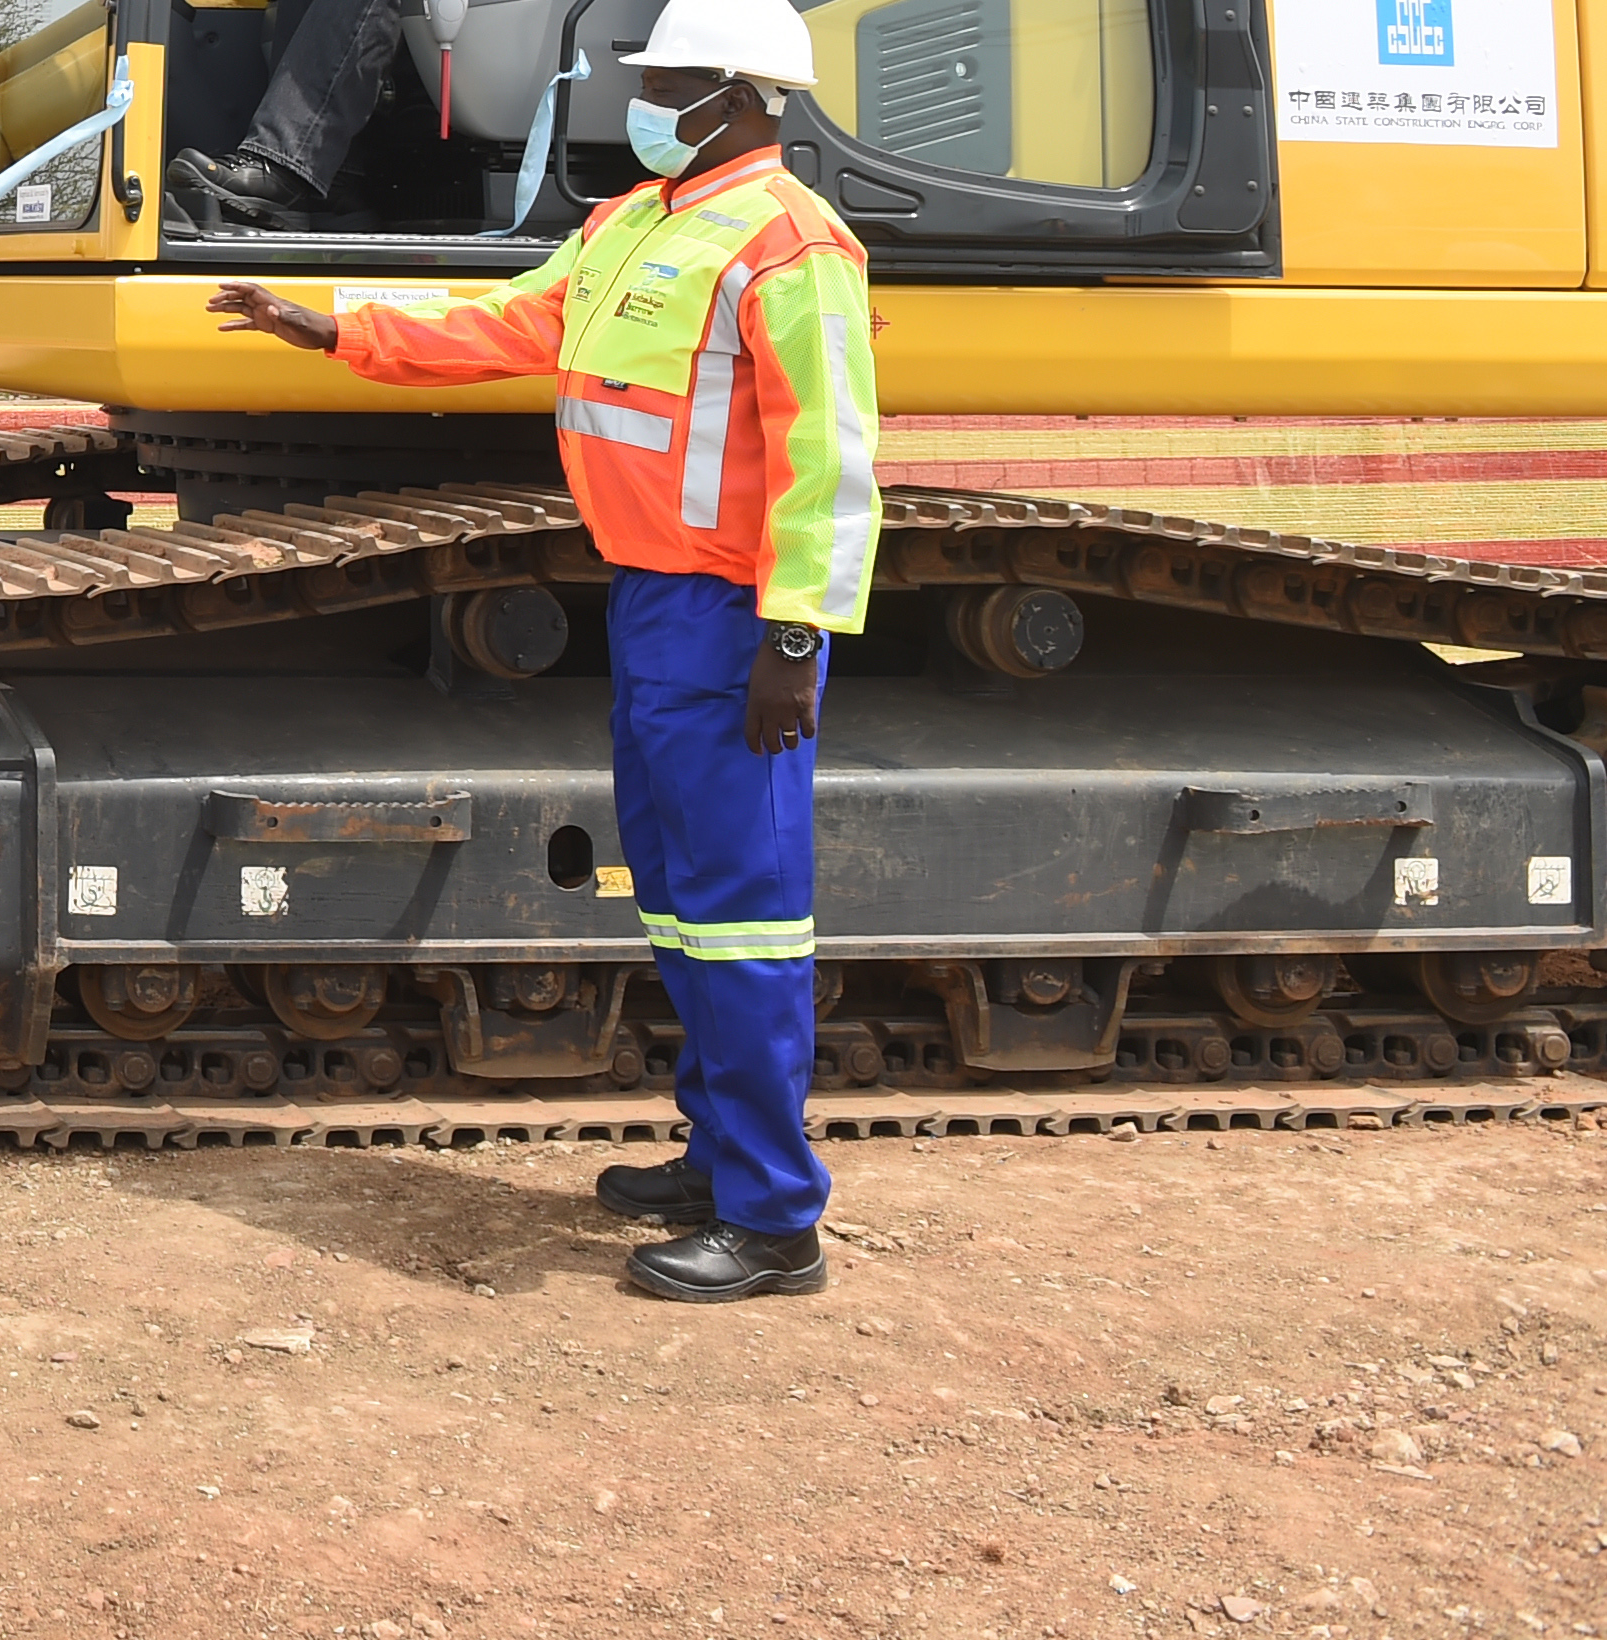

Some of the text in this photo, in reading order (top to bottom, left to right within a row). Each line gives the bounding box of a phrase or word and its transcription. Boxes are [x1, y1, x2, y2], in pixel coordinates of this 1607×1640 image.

[1290, 115, 1328, 125] CHINA
[1335, 116, 1369, 126] STATE
[1374, 117, 1461, 128] CONSTRUCTION
[339, 290, 378, 302] Supplied
[380, 291, 388, 301] &
[391, 291, 429, 301] Serviced
